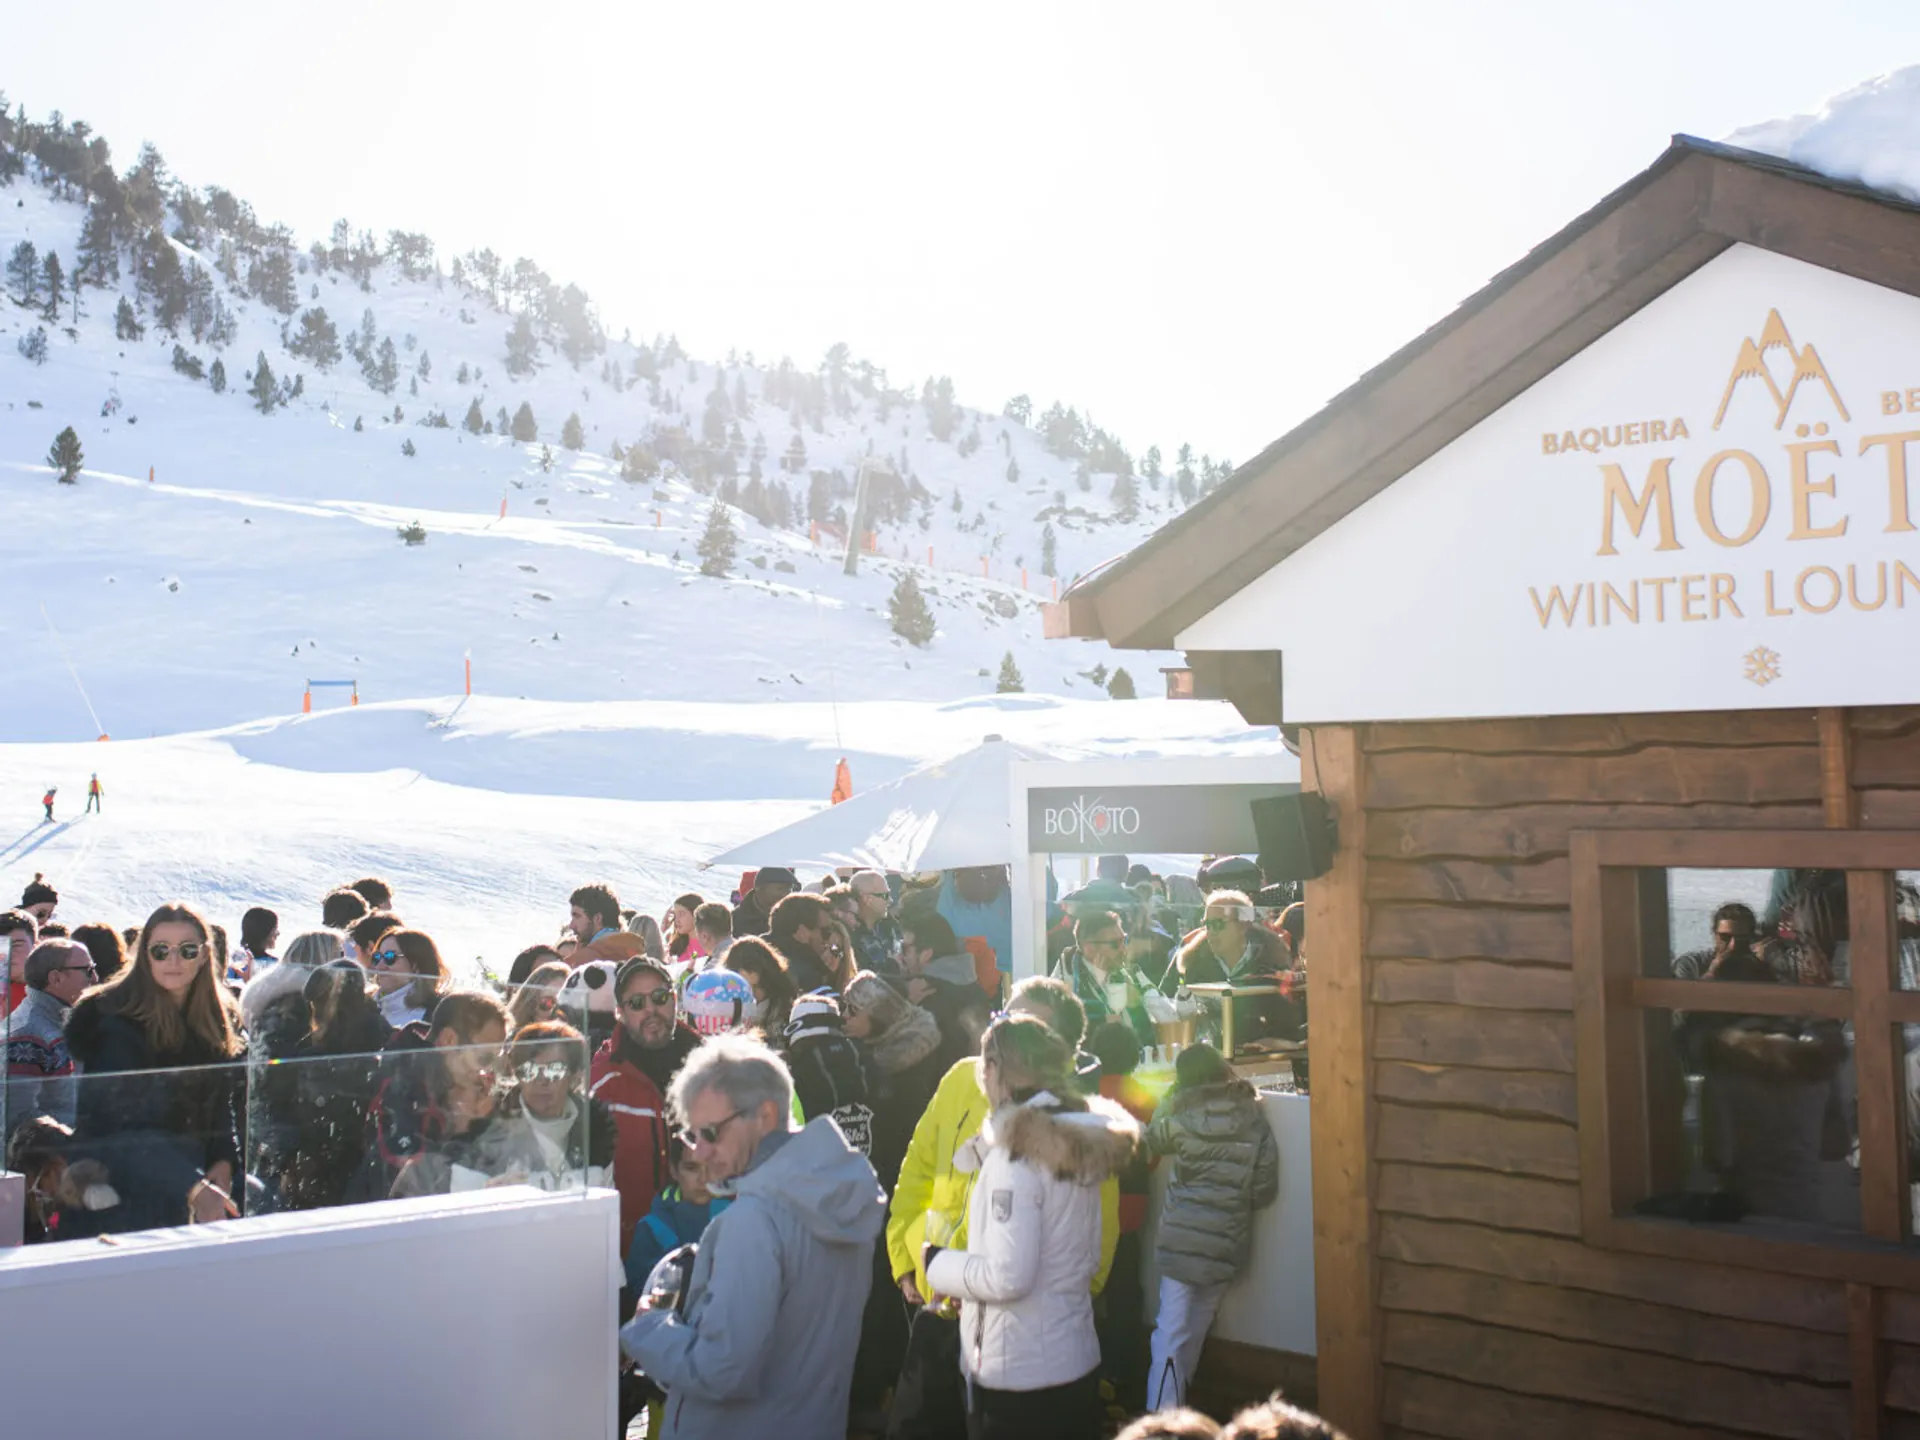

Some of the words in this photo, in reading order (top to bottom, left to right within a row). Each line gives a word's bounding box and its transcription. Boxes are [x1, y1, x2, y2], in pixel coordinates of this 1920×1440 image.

[1541, 417, 1690, 455] BAQUEIRA
[1596, 421, 1920, 556] MOËT
[1528, 572, 1745, 630] WINTER
[1044, 794, 1141, 846] BOKOTO
